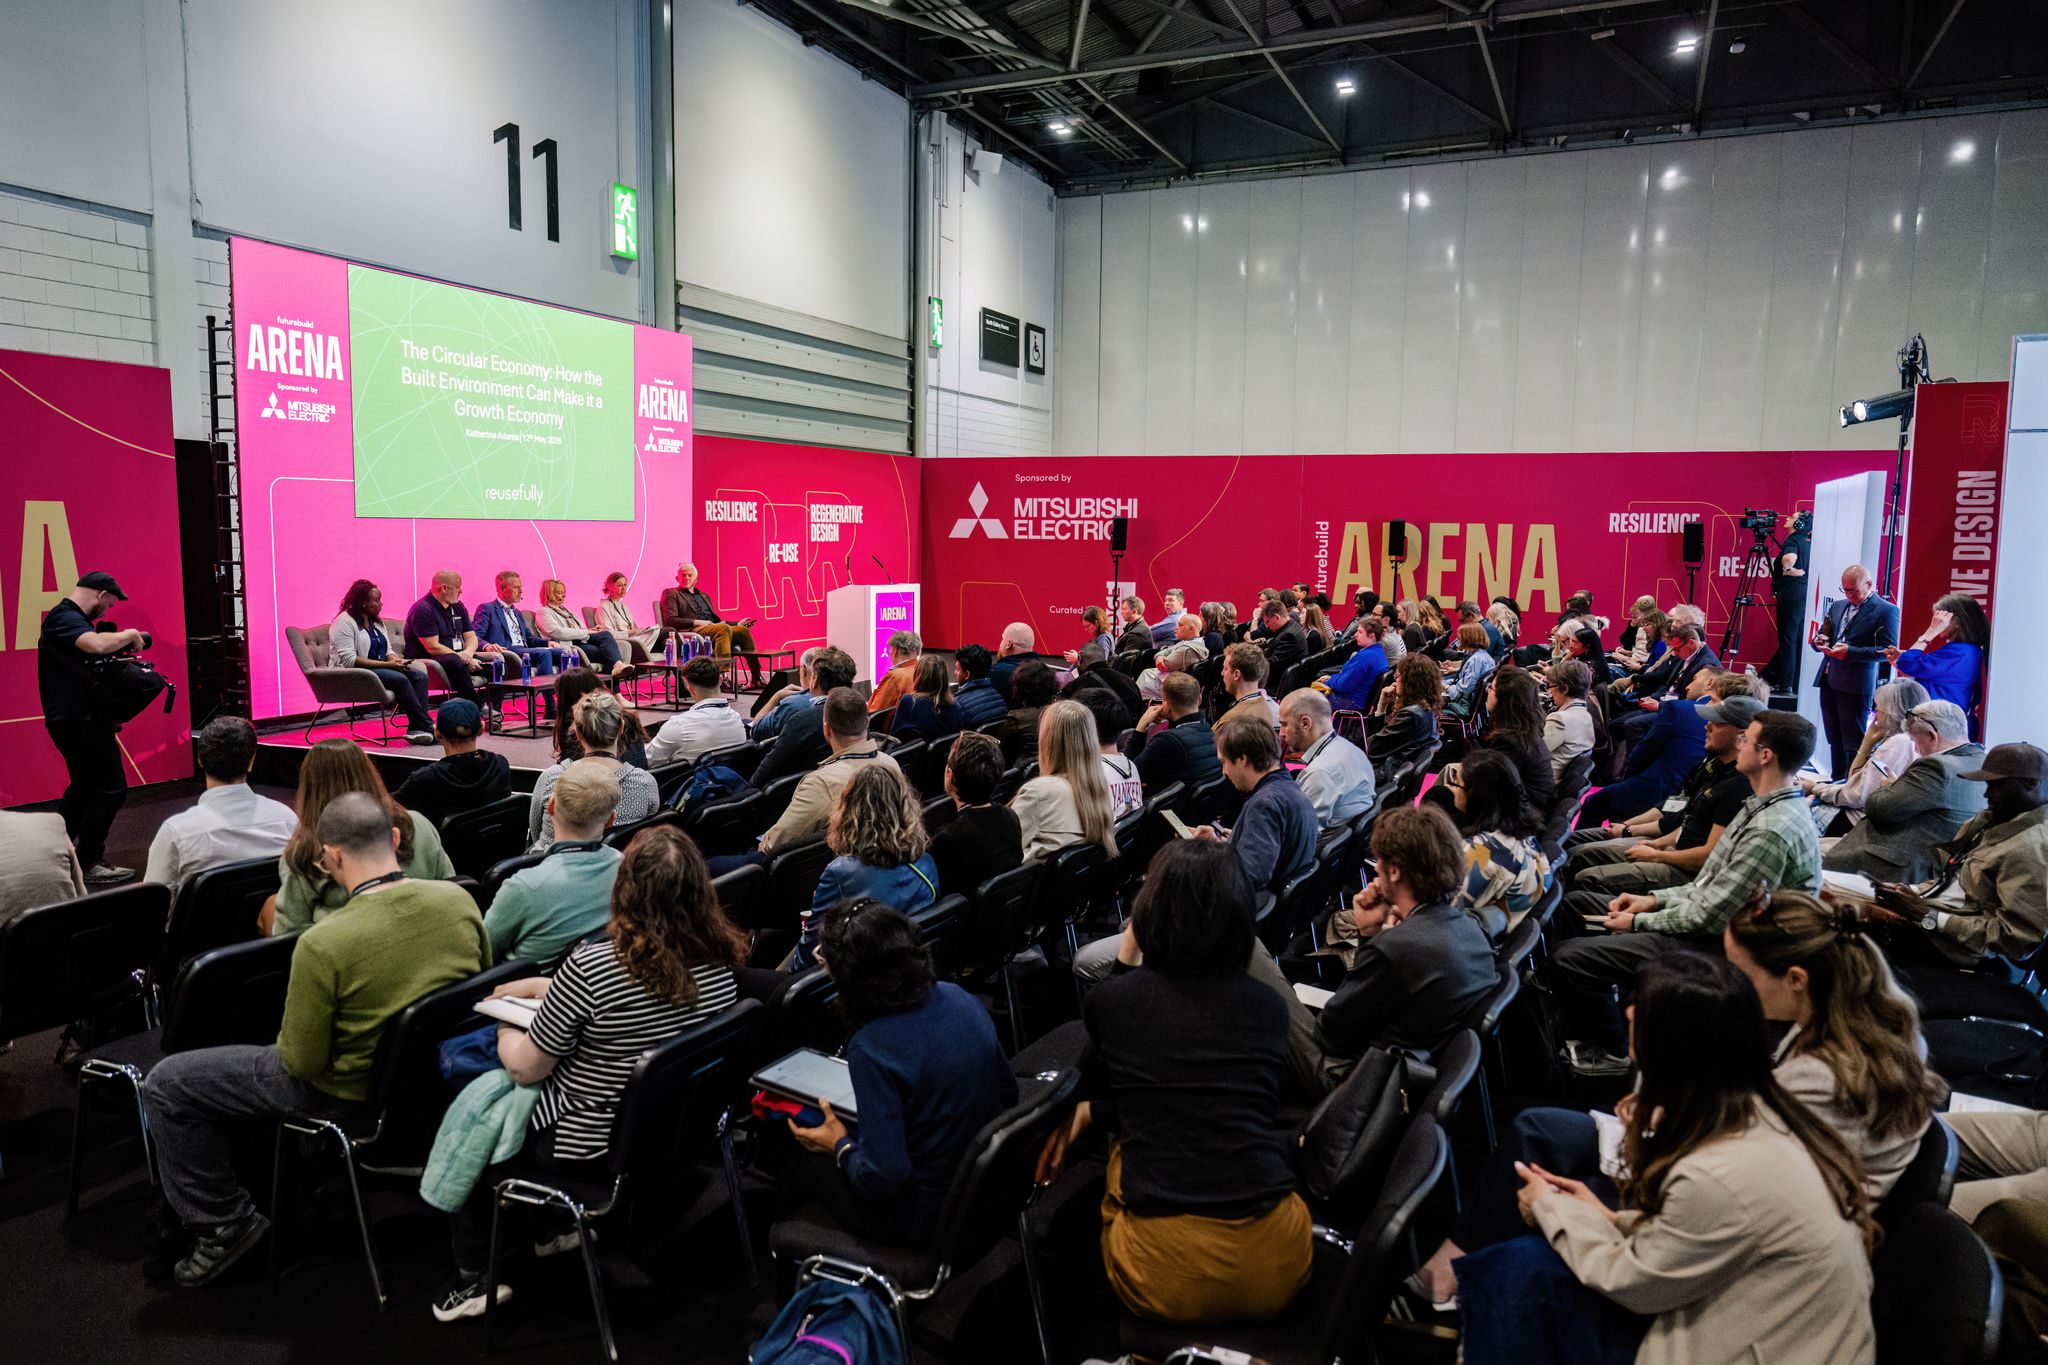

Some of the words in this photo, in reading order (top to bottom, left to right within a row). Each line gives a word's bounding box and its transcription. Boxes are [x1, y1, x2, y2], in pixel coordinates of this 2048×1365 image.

[494, 122, 560, 243] 11
[276, 315, 314, 329] futurebuild
[247, 323, 344, 381] ARENA
[400, 339, 429, 361] The
[432, 345, 488, 370] Circular
[491, 354, 553, 383] Economy:
[555, 364, 583, 382] How
[584, 370, 603, 387] the
[277, 383, 310, 393] Sponsored
[310, 385, 318, 394] by
[401, 366, 436, 388] Built
[439, 371, 524, 399] Environment
[526, 384, 551, 402] Can
[554, 387, 584, 407] Make
[586, 392, 595, 408] it
[595, 397, 603, 409] a
[288, 400, 336, 414] MITSUBISHI
[454, 399, 504, 421] Growth
[507, 405, 564, 430] Economy
[638, 384, 688, 423] ARENA
[288, 410, 330, 423] ELECTRIC
[1015, 473, 1059, 483] Sponsored
[1061, 473, 1072, 483] by
[485, 483, 543, 507] reusefully
[705, 500, 758, 522] RESILIENCE
[810, 503, 864, 524] REGENERATIVE
[1014, 497, 1138, 519] MITSUBISHI
[1952, 470, 1997, 561] DESIGN
[810, 522, 840, 542] DESIGN
[769, 543, 799, 563] RE-USE
[1314, 521, 1330, 593] turebuild
[1331, 521, 1562, 613] ARENA
[1719, 556, 1777, 578] RE-US
[882, 606, 907, 621] ARENA
[1049, 605, 1084, 615] Curated
